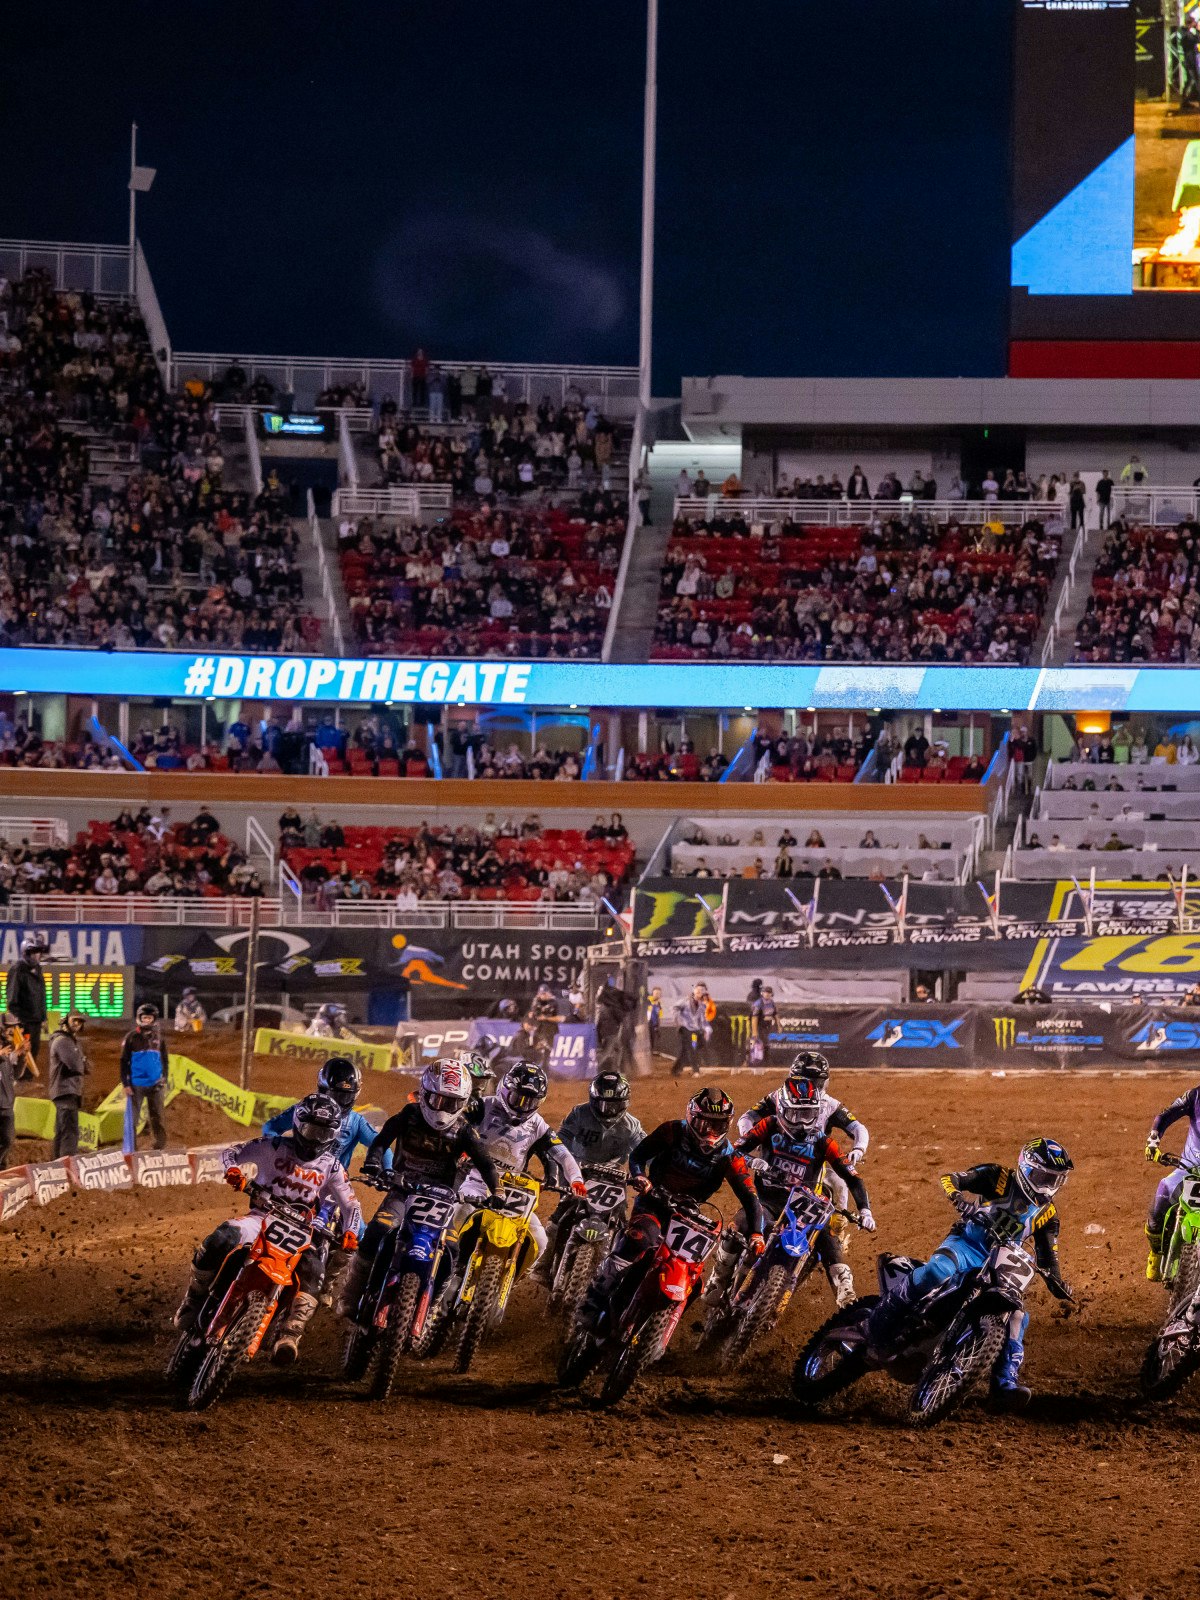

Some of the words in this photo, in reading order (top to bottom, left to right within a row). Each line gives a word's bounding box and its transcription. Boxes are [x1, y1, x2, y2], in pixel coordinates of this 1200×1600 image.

[184, 657, 532, 702] #DROPTHEGATE
[462, 944, 519, 959] UTAH
[530, 944, 608, 960] SPOR
[1035, 1019, 1084, 1029] MONSTER
[185, 1068, 247, 1118] Kawasaki
[493, 1158, 516, 1171] ZUKI
[587, 1184, 622, 1208] 46
[408, 1197, 454, 1227] 23
[264, 1220, 307, 1255] 62
[671, 1226, 709, 1263] 14
